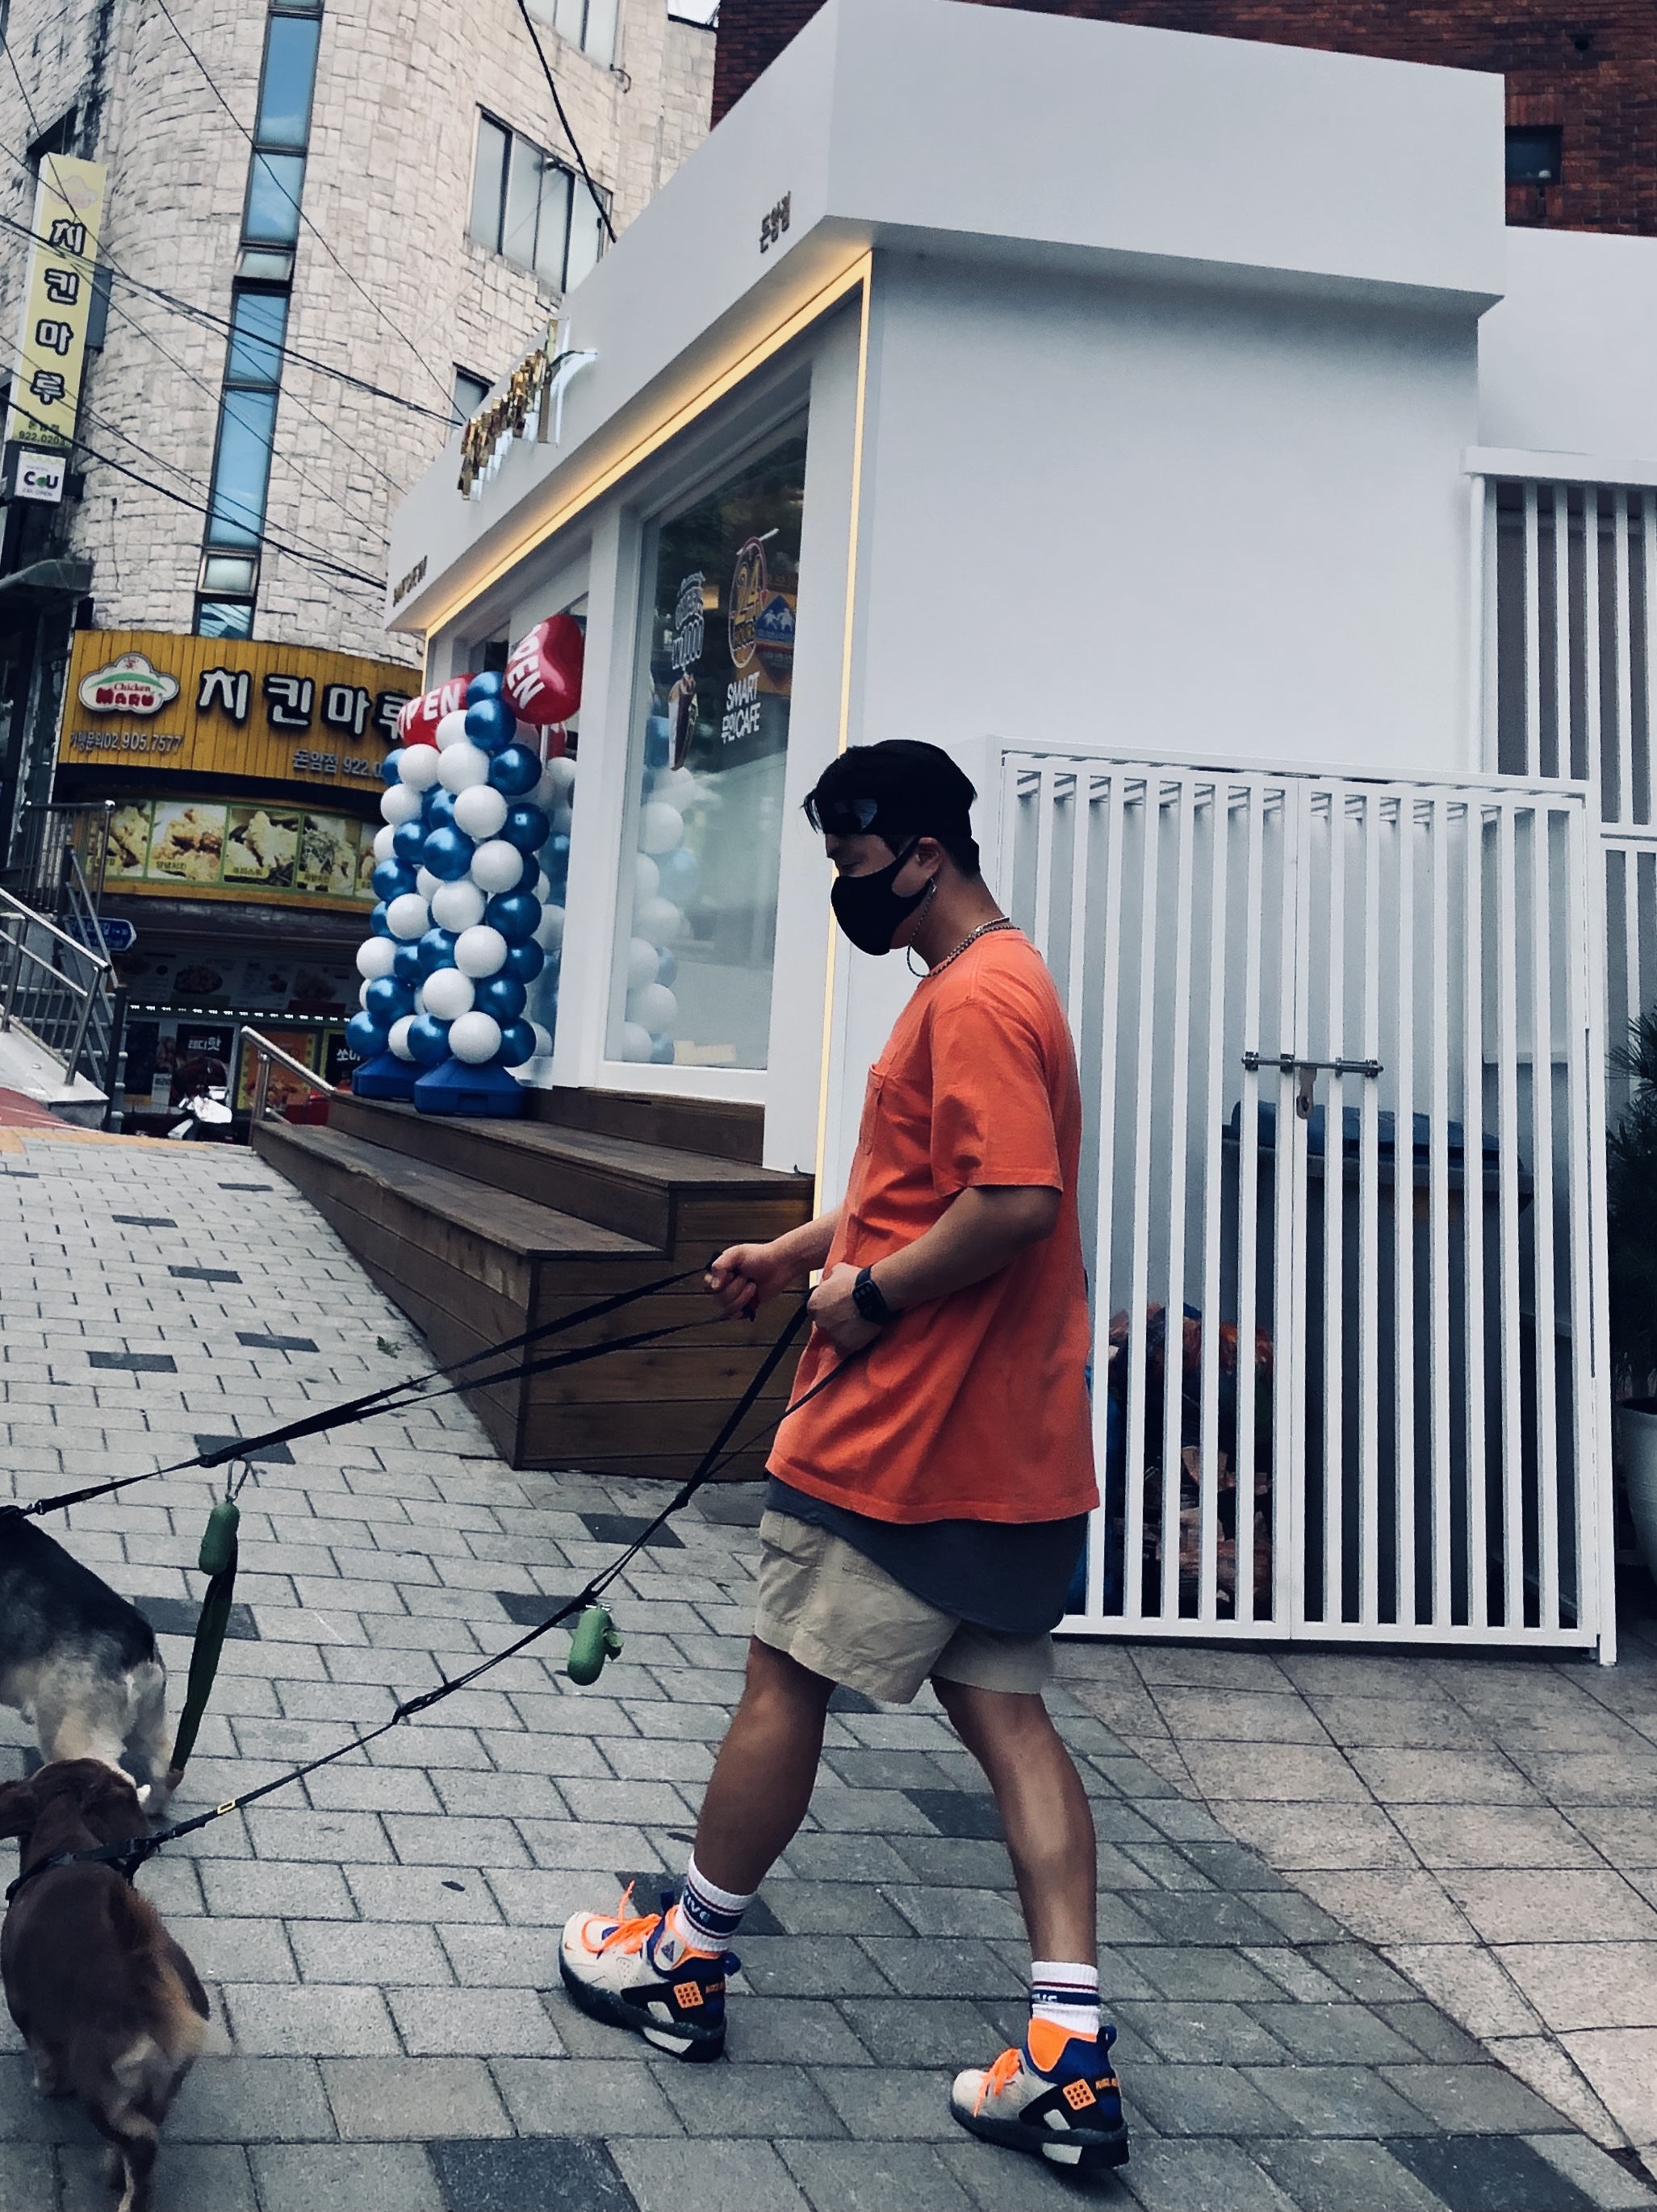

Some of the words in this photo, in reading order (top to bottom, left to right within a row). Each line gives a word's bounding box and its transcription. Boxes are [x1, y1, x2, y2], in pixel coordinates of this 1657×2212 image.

[29, 219, 86, 405] 치킨마루
[23, 471, 59, 489] CU
[114, 683, 151, 692] Chicken
[726, 671, 760, 712] SMART
[293, 749, 337, 773] 돈암점
